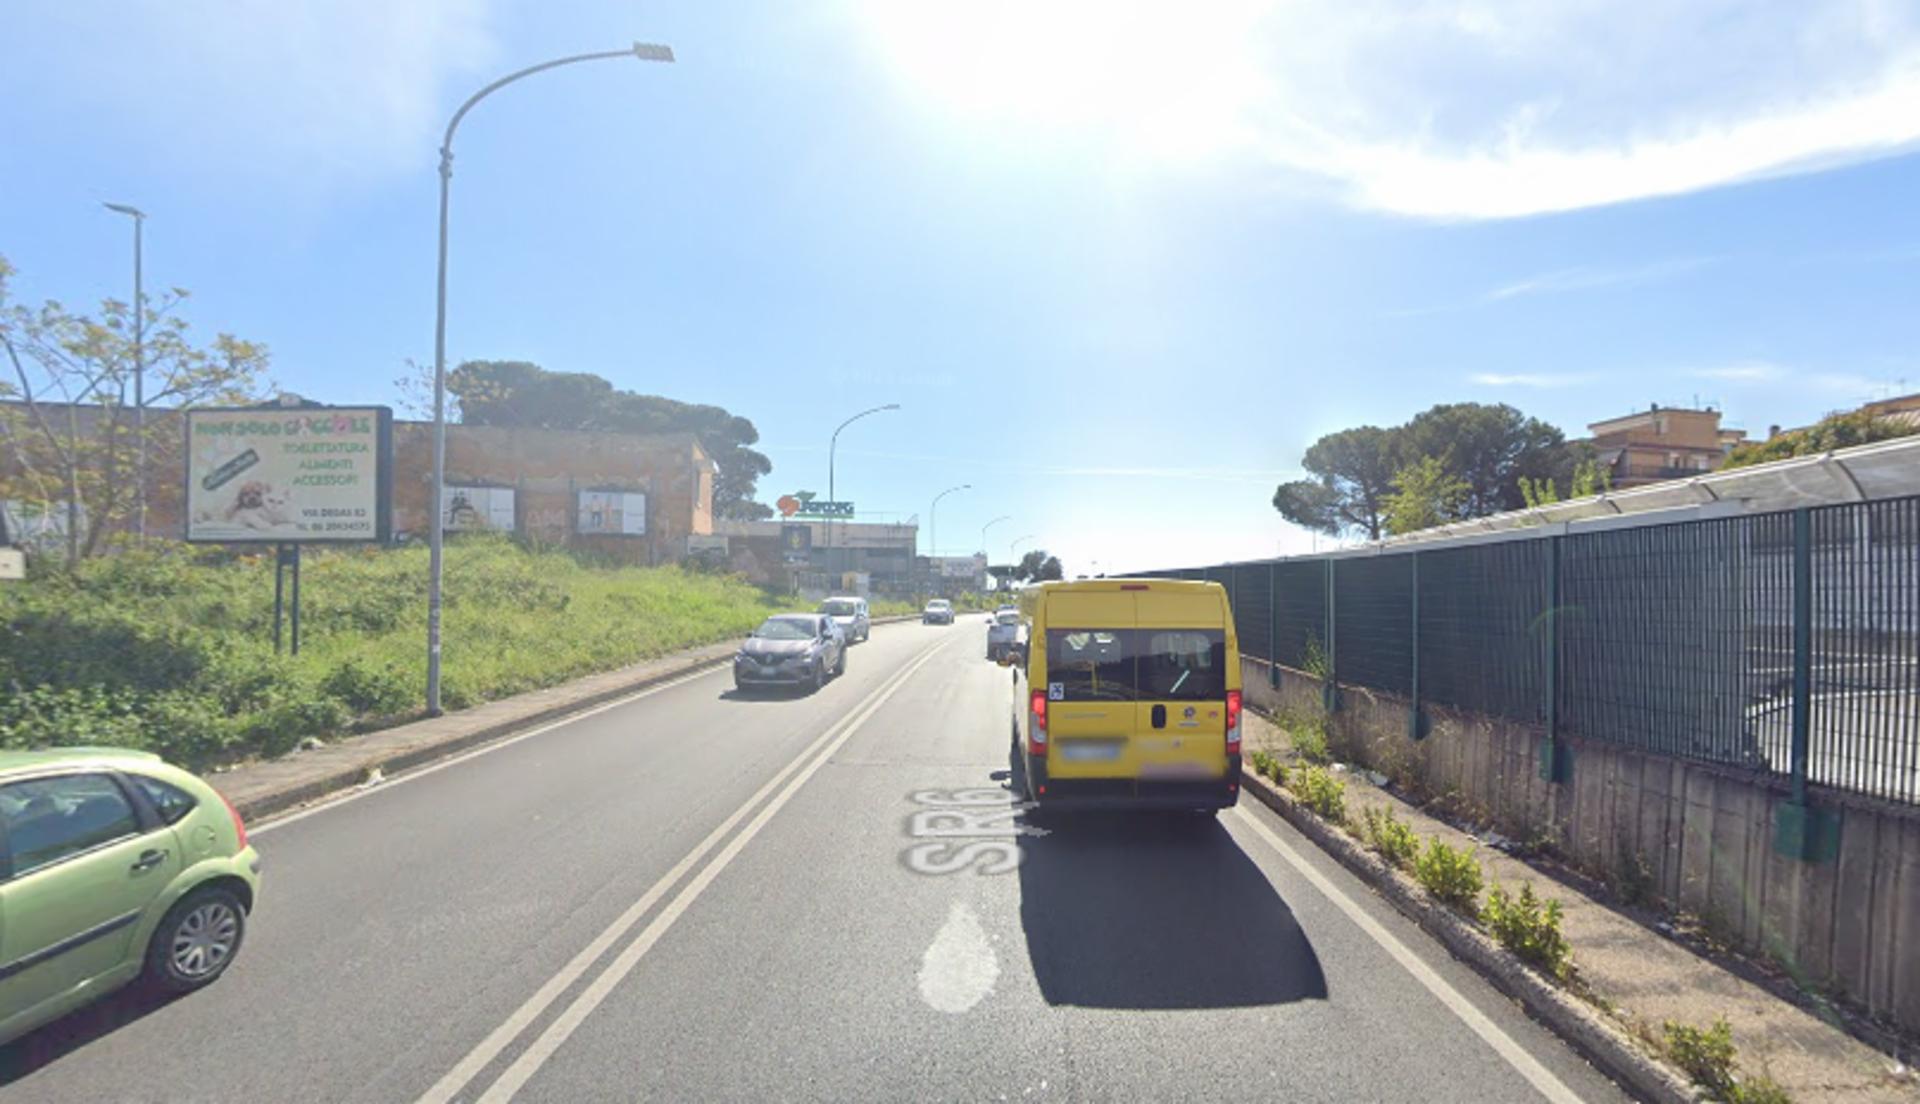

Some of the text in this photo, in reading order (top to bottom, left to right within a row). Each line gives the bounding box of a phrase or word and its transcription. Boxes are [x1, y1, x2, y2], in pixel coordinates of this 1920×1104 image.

[235, 420, 281, 435] SOLO
[299, 459, 353, 470] ALIMENTI
[293, 474, 358, 486] ACCESSORI
